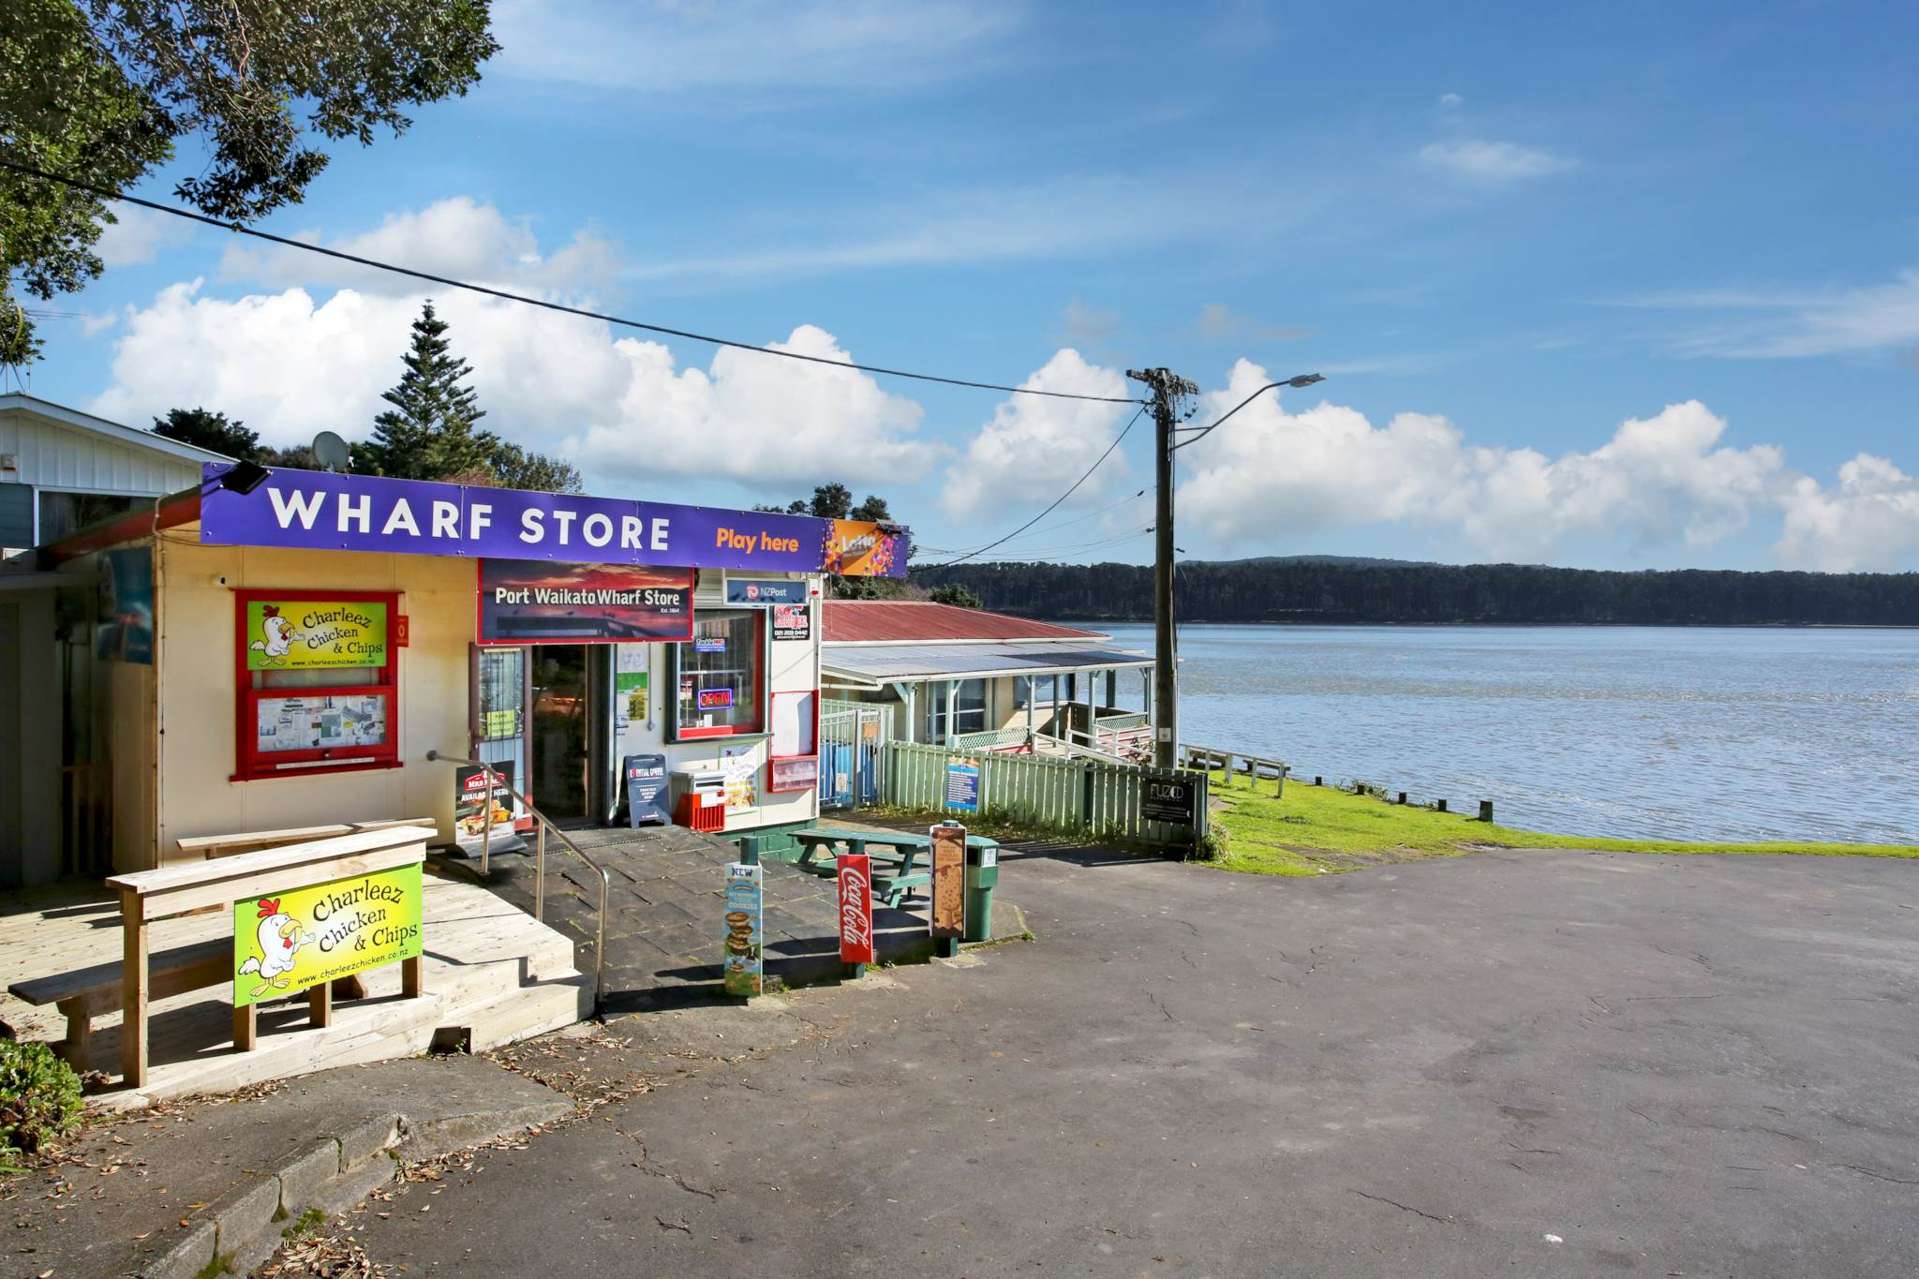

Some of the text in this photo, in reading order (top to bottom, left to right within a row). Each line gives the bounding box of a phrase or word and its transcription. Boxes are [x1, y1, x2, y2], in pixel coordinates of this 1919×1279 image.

[267, 487, 670, 551] WHARF STORE
[716, 528, 799, 554] Play here
[495, 587, 680, 606] Port Waikato Wharf Store
[303, 607, 372, 629] Charleez
[307, 627, 358, 650] Chicken
[333, 642, 383, 657] & Chips
[700, 691, 730, 706] OPEN
[731, 867, 753, 877] NEW
[312, 879, 404, 921] Charleez
[319, 908, 386, 953] Chicken
[354, 923, 418, 952] & Chips
